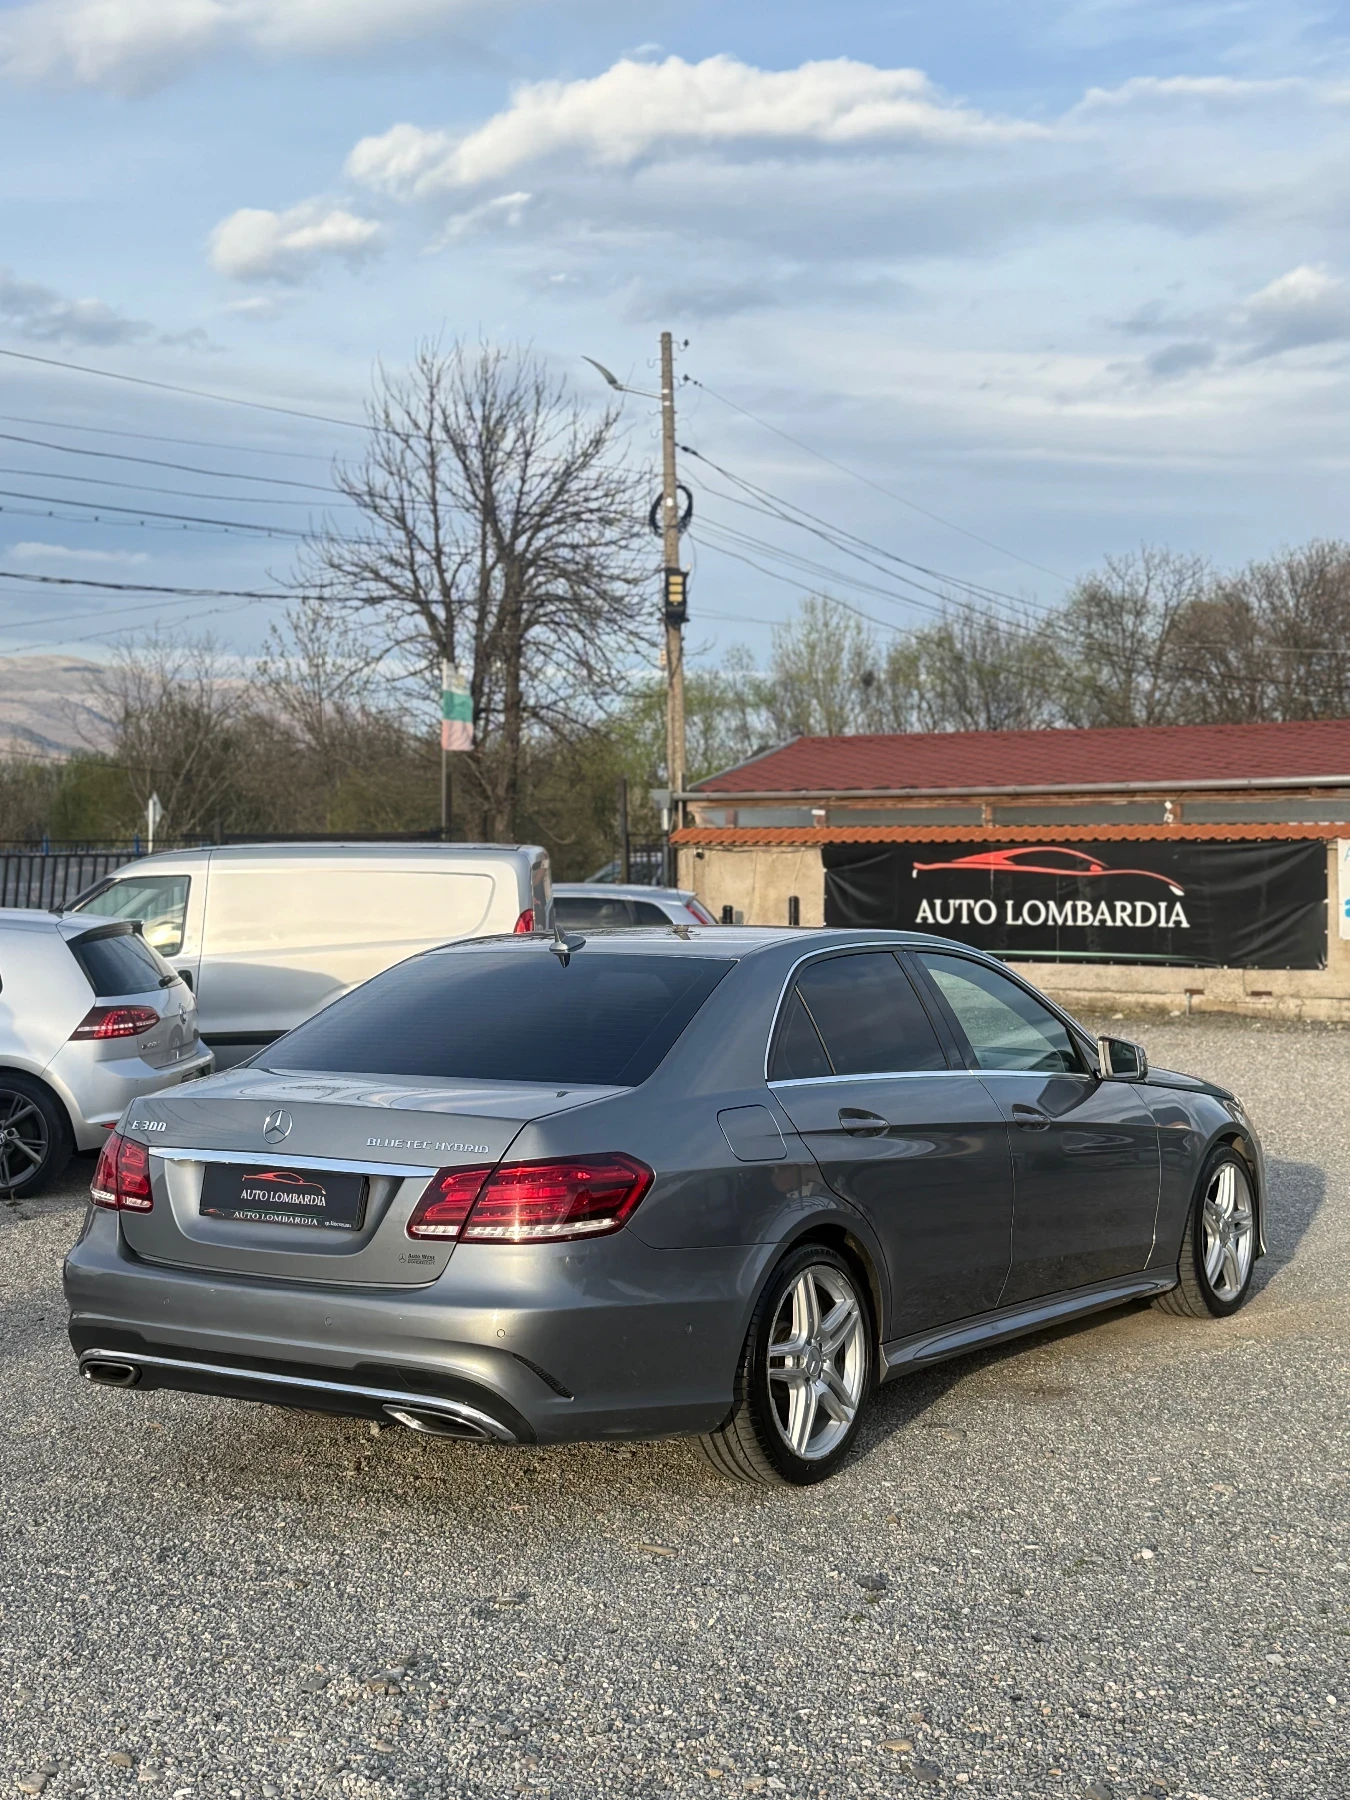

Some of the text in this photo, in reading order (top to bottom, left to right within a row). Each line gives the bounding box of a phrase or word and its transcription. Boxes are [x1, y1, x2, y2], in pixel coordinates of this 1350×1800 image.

[915, 898, 1190, 928] AUTO LOMBARDIA
[131, 1120, 167, 1132] E 300
[435, 1141, 489, 1154] HYBRID
[240, 1189, 326, 1206] AUTO LOMBARDIA
[233, 1211, 259, 1220] AUTO
[261, 1213, 318, 1225] LOMBARDIA
